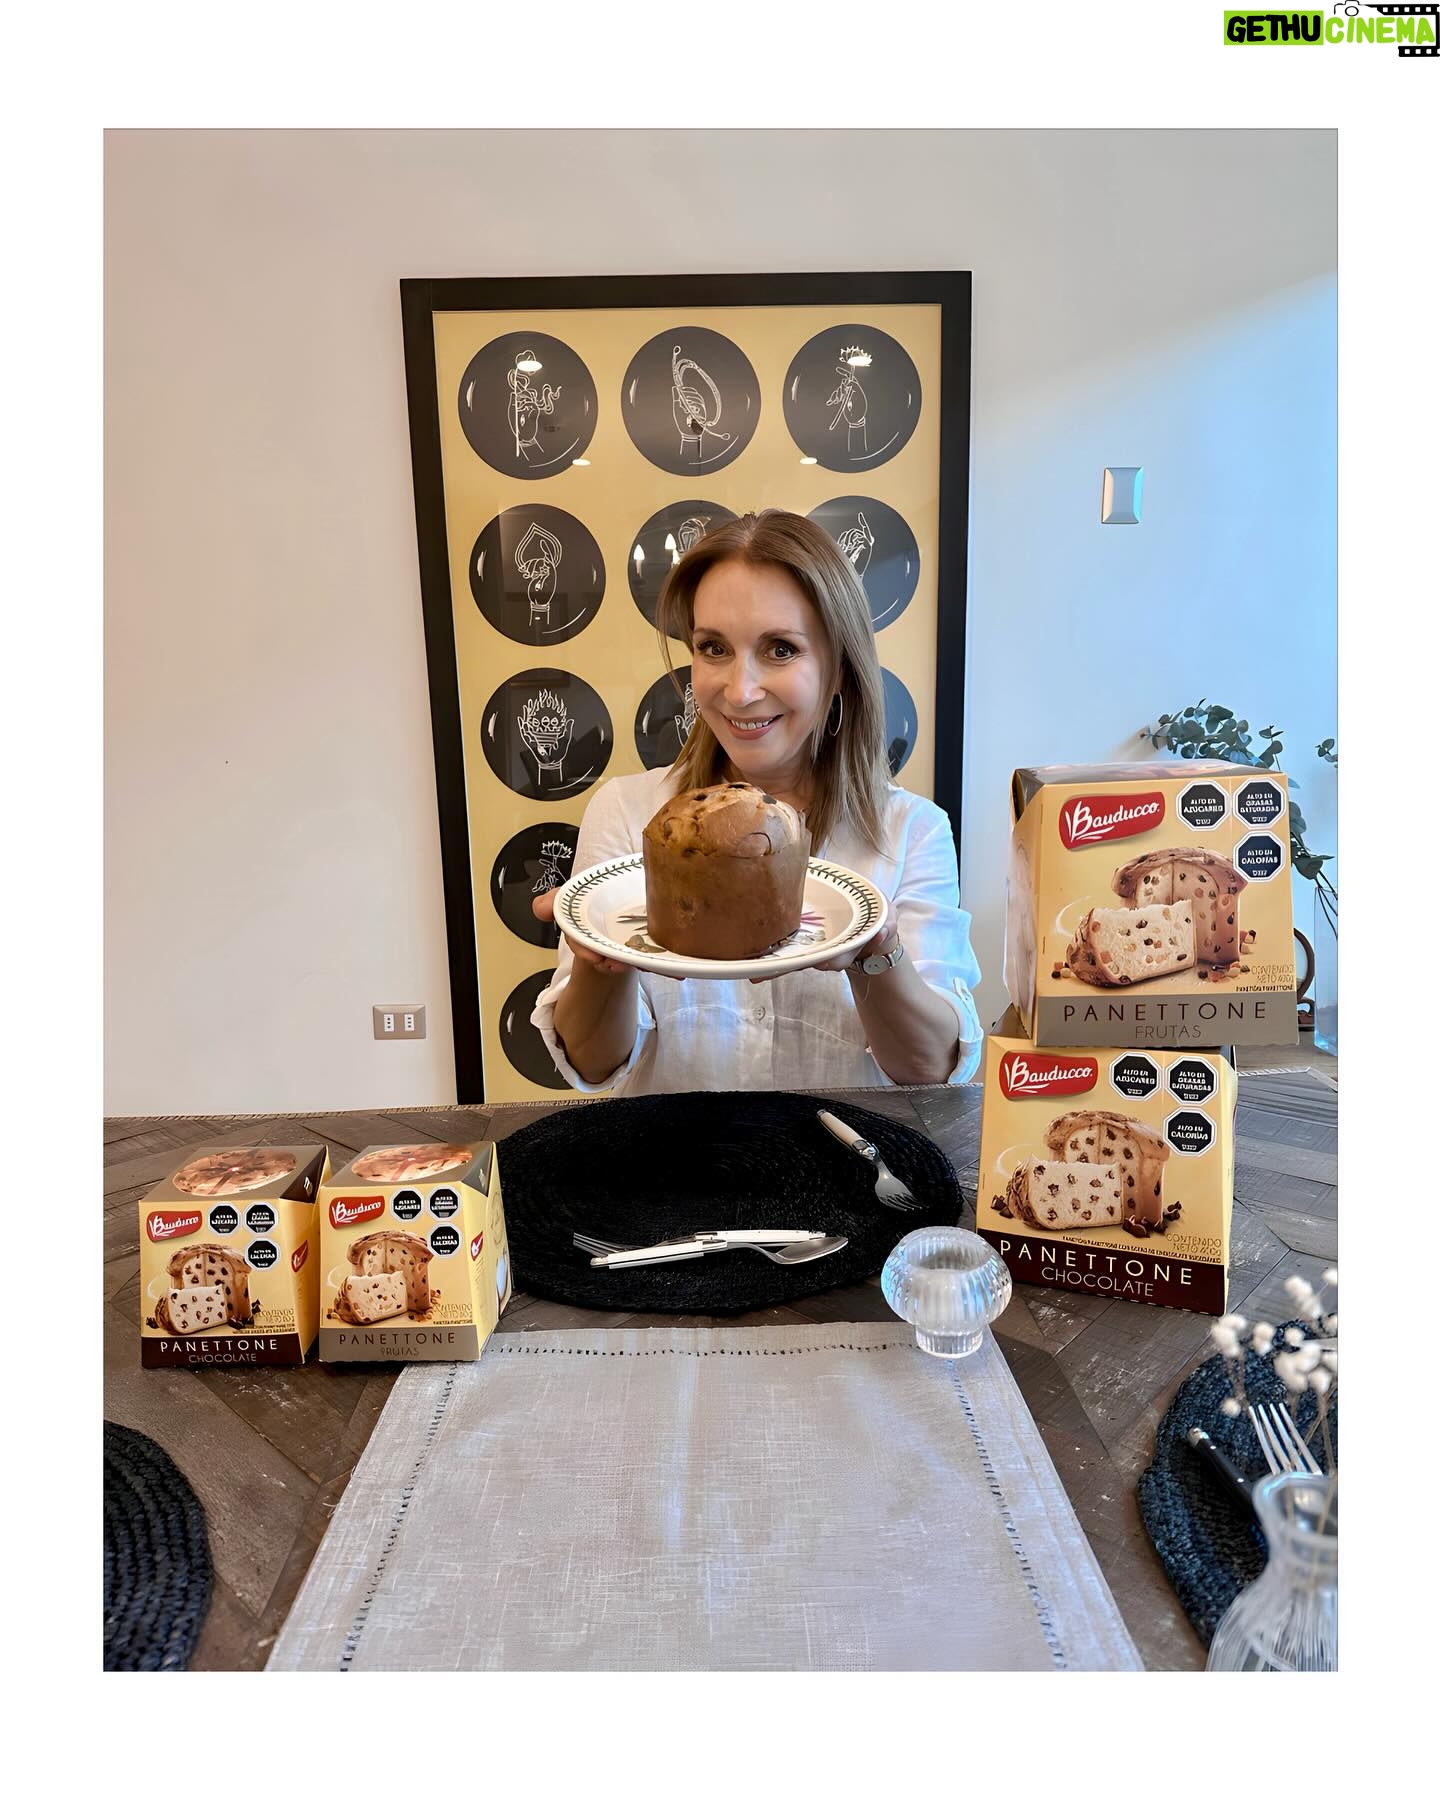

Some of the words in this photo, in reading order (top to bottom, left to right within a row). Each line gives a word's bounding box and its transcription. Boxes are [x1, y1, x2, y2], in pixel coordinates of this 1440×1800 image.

[1065, 800, 1160, 843] Bauducco
[1064, 1001, 1267, 1022] PANETTONE
[1135, 1024, 1202, 1039] FRUTAS
[1005, 1055, 1093, 1093] Bauducco
[1000, 1239, 1193, 1285] PANETTONE
[1041, 1267, 1154, 1297] CHOCOLATE
[160, 1338, 279, 1353] PANETTONE
[339, 1332, 456, 1345] PANETTONE
[188, 1353, 257, 1364] CHOCOLATE
